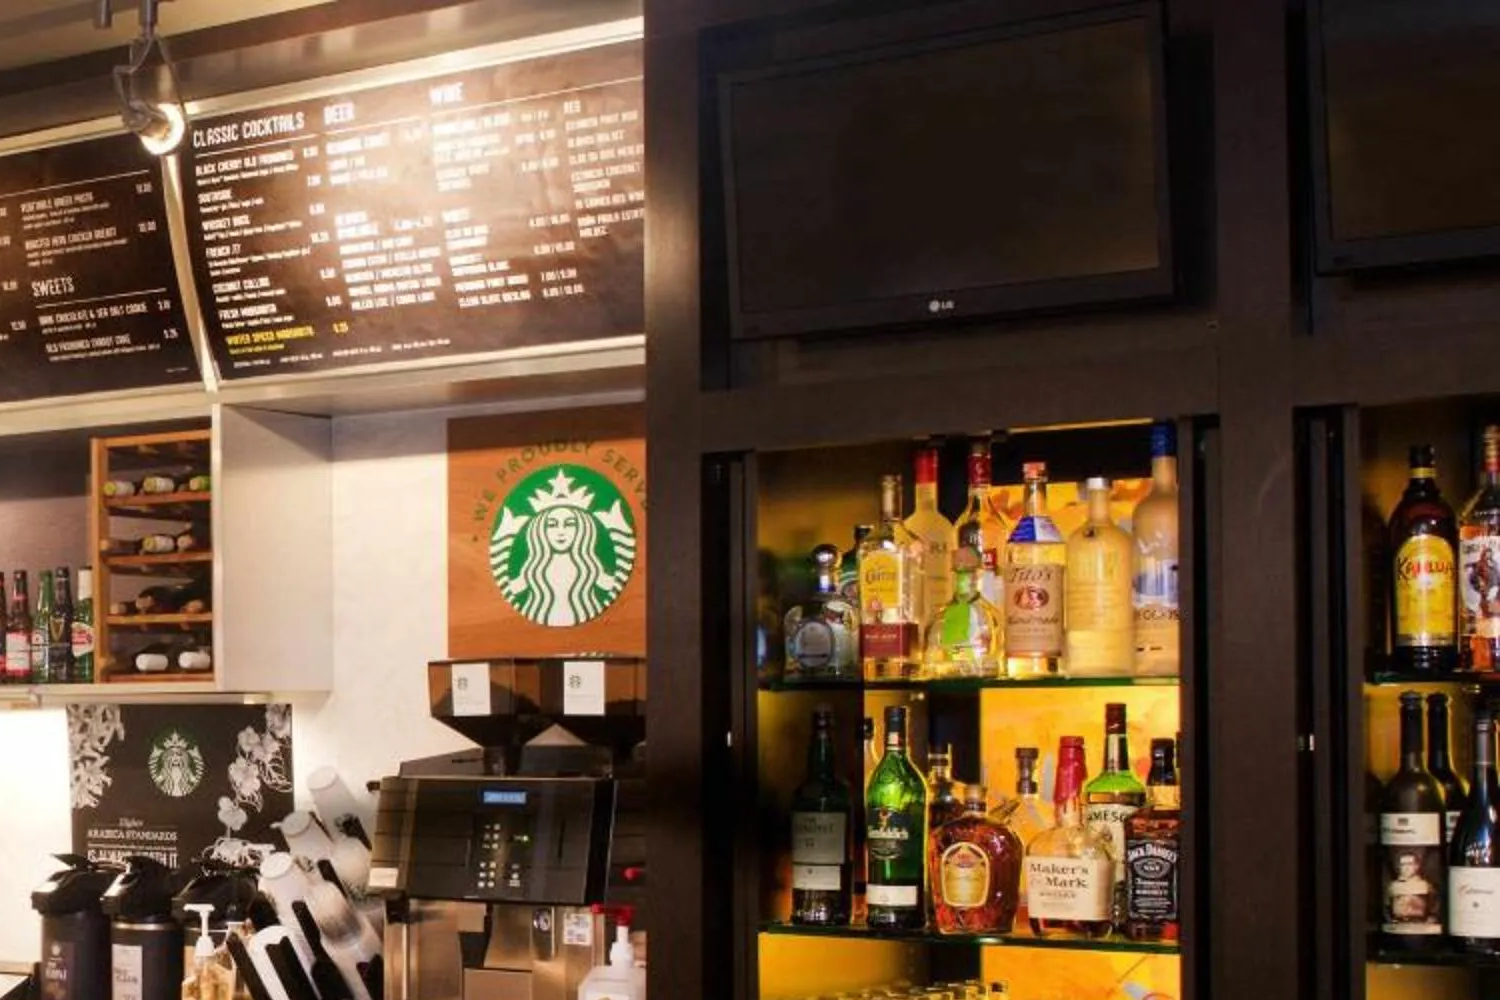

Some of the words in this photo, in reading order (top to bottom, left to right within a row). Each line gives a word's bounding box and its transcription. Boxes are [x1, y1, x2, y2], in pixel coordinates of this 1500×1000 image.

[193, 123, 239, 148] CLASSIC
[243, 111, 305, 139] COCKTAILS
[31, 276, 75, 297] SWEETS
[473, 489, 497, 522] WE
[496, 438, 598, 483] PROUDLY
[126, 830, 178, 842] STANDARDS
[1030, 863, 1089, 876] Maker's
[1045, 877, 1088, 889] Mark
